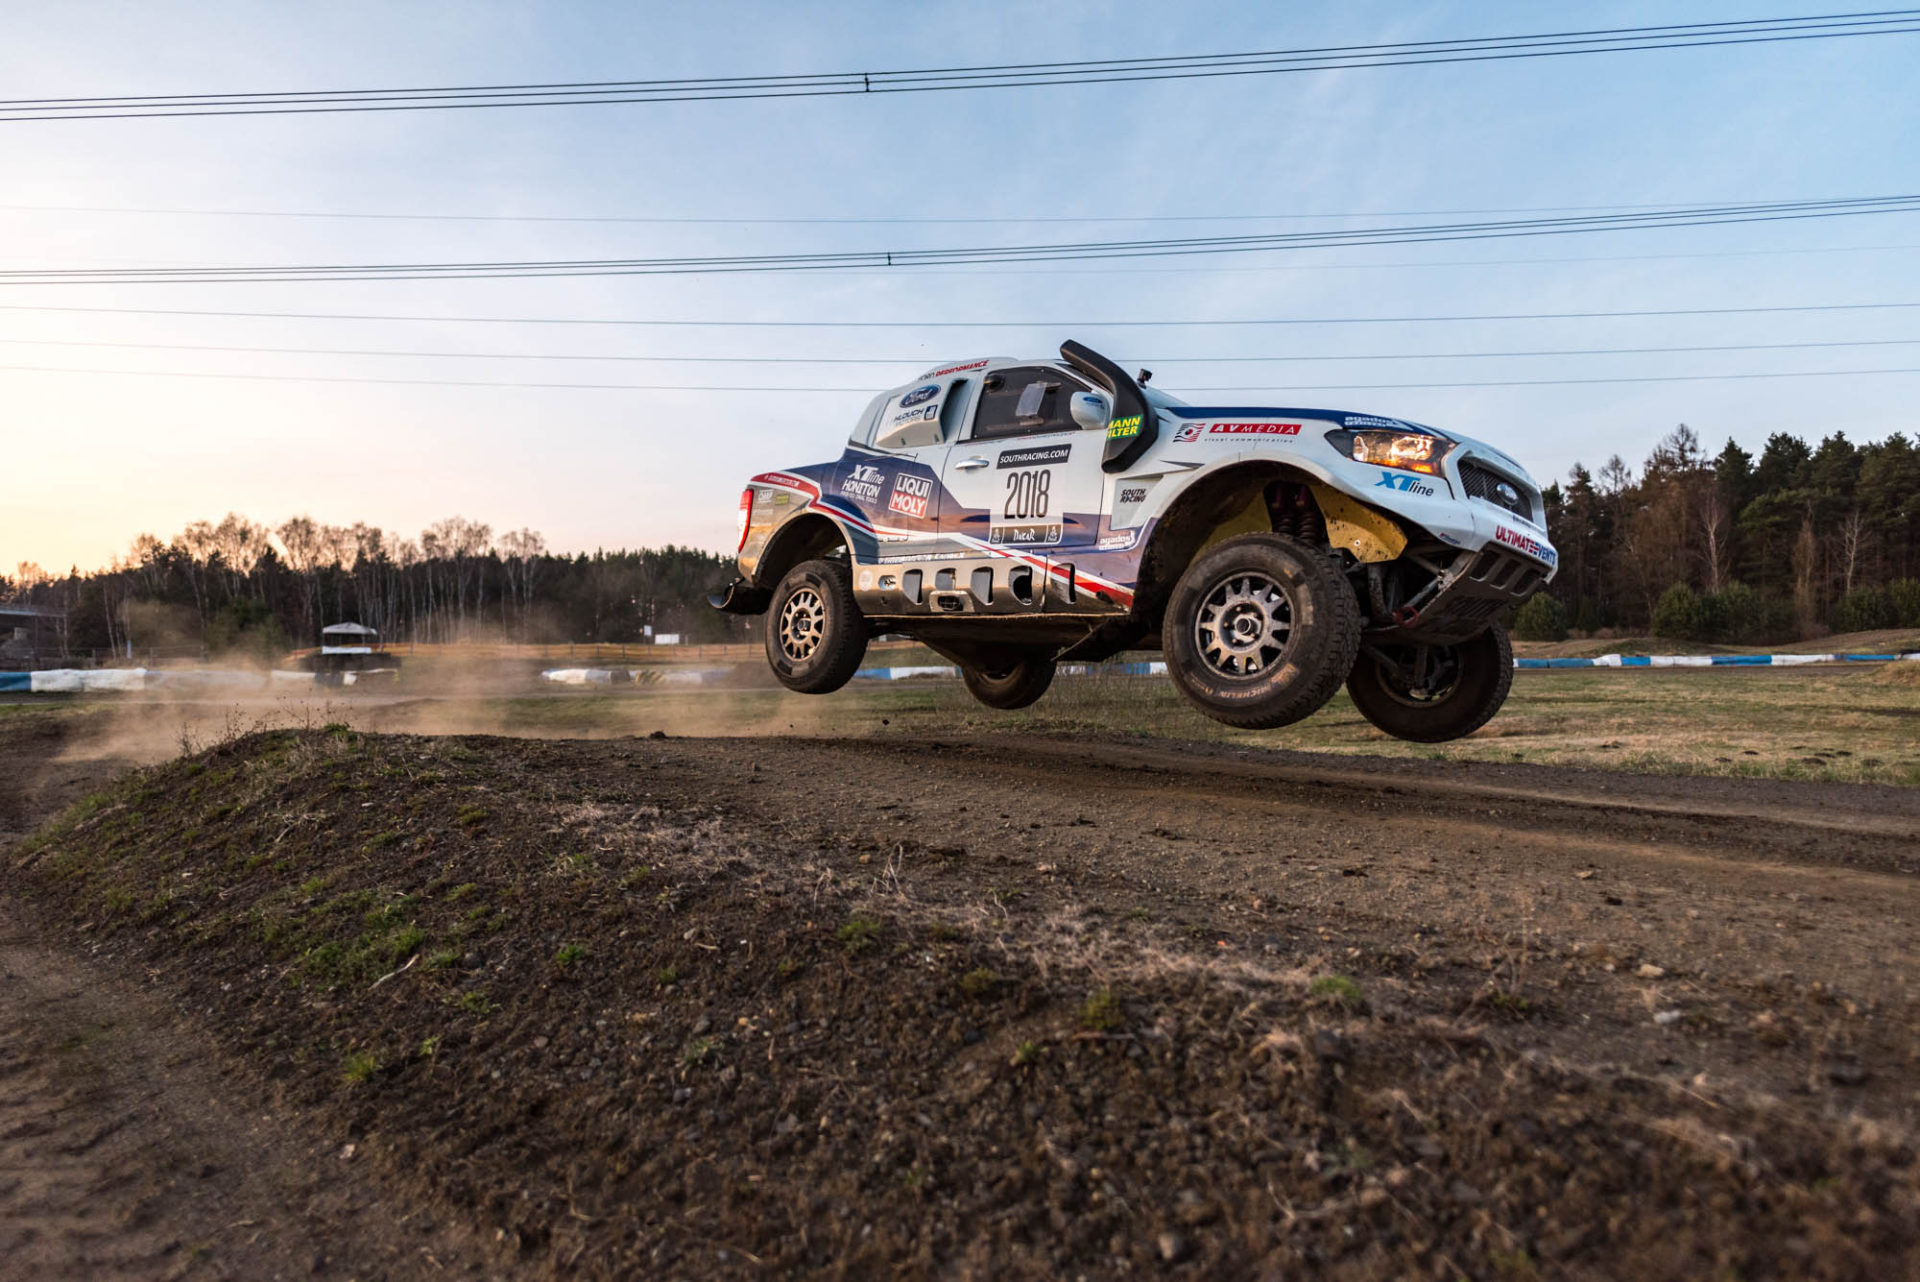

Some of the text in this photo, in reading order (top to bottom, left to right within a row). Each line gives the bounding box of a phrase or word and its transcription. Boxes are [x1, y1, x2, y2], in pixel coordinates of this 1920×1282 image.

[1107, 426, 1138, 439] ILTER
[999, 449, 1069, 464] SOUTHRACING.COM
[896, 475, 931, 498] LIQUI
[1121, 488, 1146, 496] SOUTH
[1374, 471, 1434, 497] XTline
[891, 492, 926, 514] MOLY
[1004, 469, 1052, 520] 2018
[1119, 495, 1146, 504] RACING
